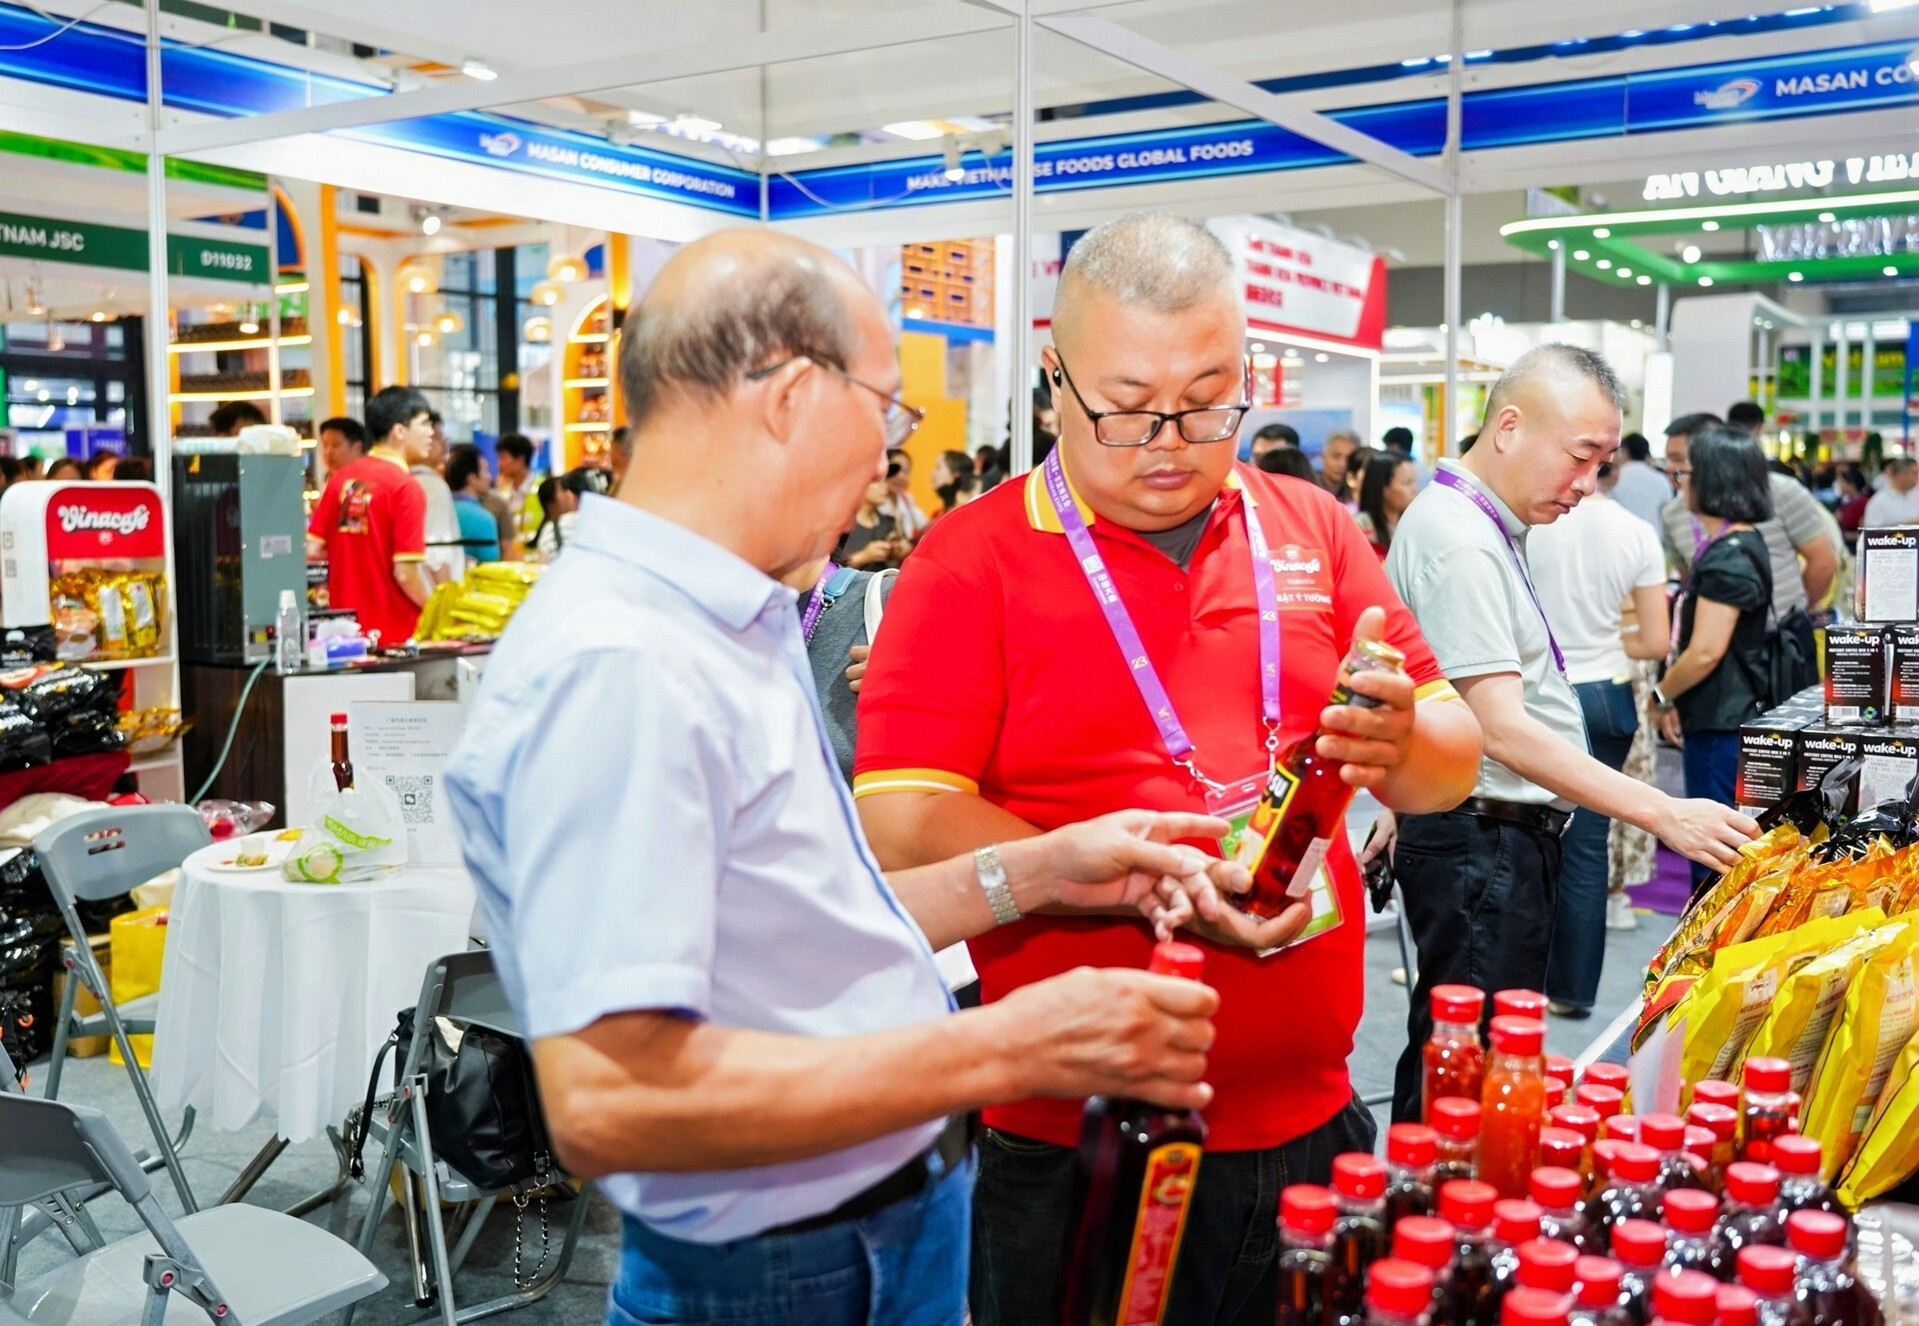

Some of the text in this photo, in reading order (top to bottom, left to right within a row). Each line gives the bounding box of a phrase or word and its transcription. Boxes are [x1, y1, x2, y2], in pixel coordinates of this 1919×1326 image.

[1775, 69, 1868, 97] MASAN
[1055, 155, 1114, 176] FOODS
[1116, 147, 1187, 170] GLOBAL
[1190, 139, 1254, 161] FOODS
[528, 142, 579, 167] MASAN
[580, 151, 651, 180] CONSUMER
[652, 167, 735, 199] CORPORATION
[48, 230, 85, 252] JSC
[58, 504, 150, 535] Vinacafé
[1867, 535, 1917, 548] wake-up
[1829, 634, 1880, 647] wake-up
[1743, 735, 1794, 749] wake-up
[1804, 739, 1857, 753] wake-up
[1863, 743, 1917, 758] wake-up
